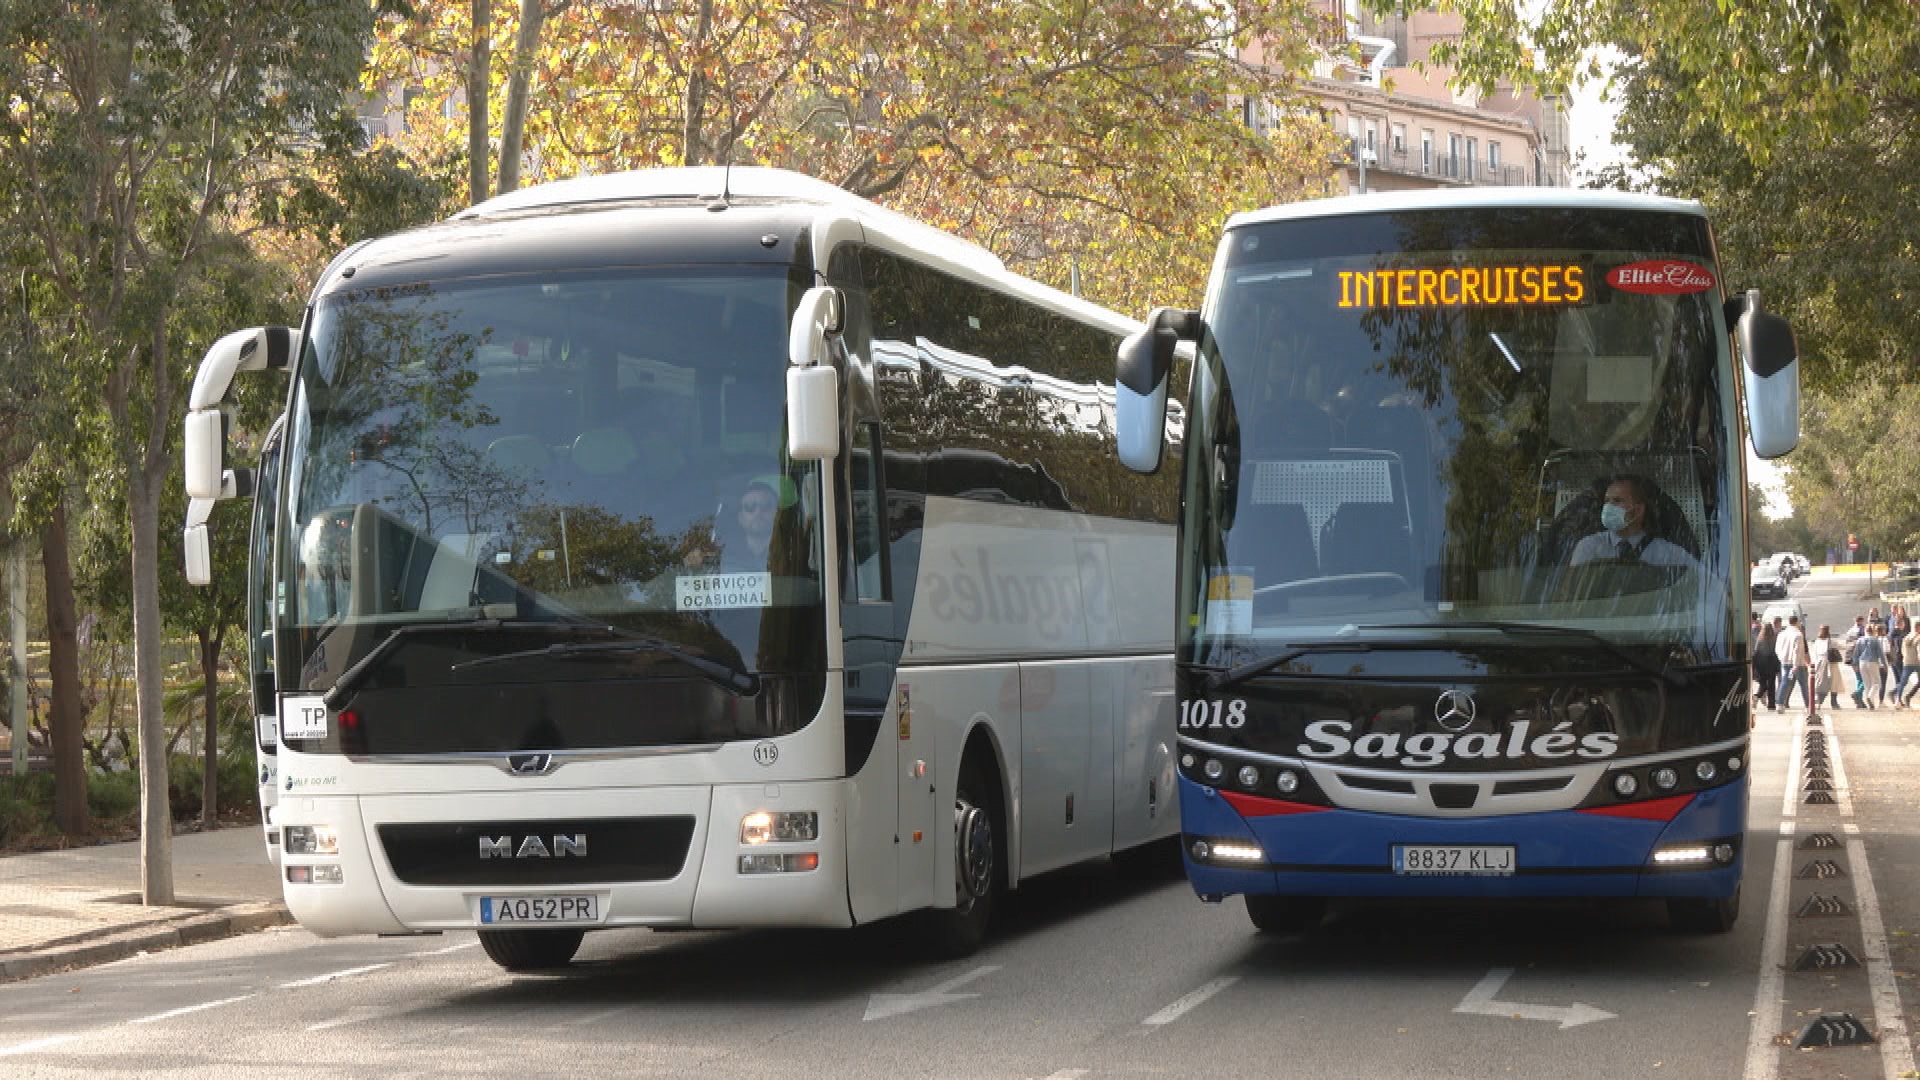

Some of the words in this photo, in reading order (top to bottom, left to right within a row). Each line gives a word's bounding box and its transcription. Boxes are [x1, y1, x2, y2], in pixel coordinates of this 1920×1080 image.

[1338, 265, 1584, 307] INTERCRUISES
[1617, 269, 1663, 285] Elite
[1663, 263, 1712, 288] Class
[683, 592, 768, 607] OCASIONAL
[301, 707, 326, 726] TP
[1179, 699, 1247, 729] 1018
[1297, 719, 1619, 767] Sagalés
[479, 833, 588, 859] MAN
[1408, 849, 1462, 869] 8837
[1469, 849, 1510, 869] KLJ
[498, 897, 591, 920] AQ52PR
